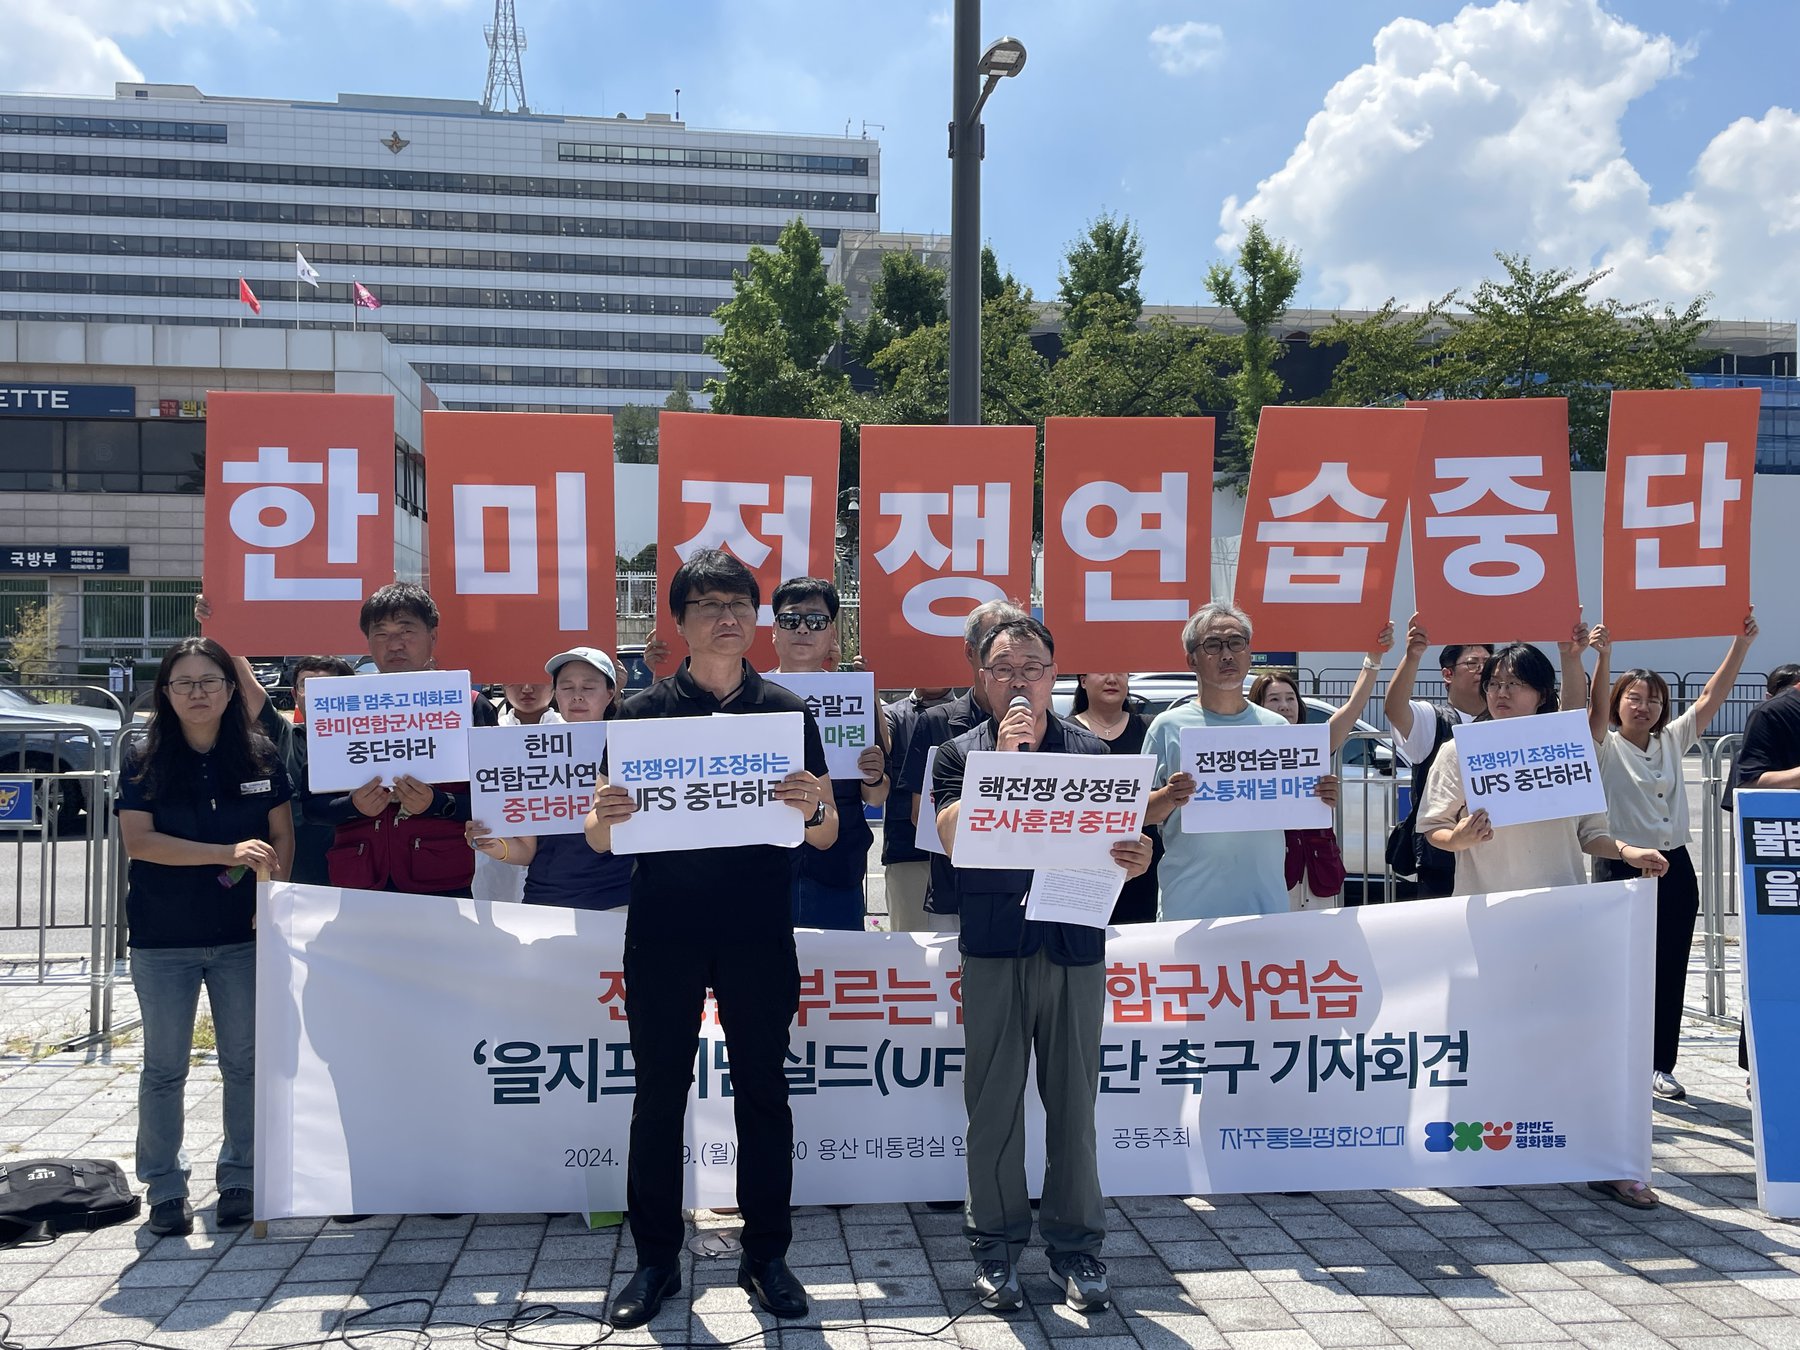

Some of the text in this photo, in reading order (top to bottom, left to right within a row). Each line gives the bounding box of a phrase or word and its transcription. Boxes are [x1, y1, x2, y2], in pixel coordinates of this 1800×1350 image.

[223, 447, 379, 601] 한
[452, 472, 589, 631] 미
[874, 482, 1011, 637] 쟁
[1061, 472, 1189, 622] 연
[1256, 462, 1388, 603] 습
[1425, 455, 1558, 596] 중
[1623, 442, 1741, 590] 단
[10, 551, 57, 567] 국방부
[313, 689, 463, 713] 적대를 멈추고 대화로!
[315, 710, 462, 737] 한미연합군사연습
[825, 724, 866, 748] 마련
[347, 736, 436, 764] 중단하라
[524, 732, 573, 759] 한미
[1467, 742, 1585, 772] 전쟁위기 조장하는
[621, 752, 791, 782] 전쟁위기 조장하는
[1195, 747, 1321, 774] 전쟁연습말고
[476, 762, 597, 793] 연합군사연
[978, 776, 1141, 803] 핵전쟁 상정한
[1194, 777, 1278, 801] 소통채널
[1471, 761, 1592, 796] UFS 중단하라
[968, 808, 1138, 834] 군사훈련 중단!
[1156, 1038, 1260, 1095] 촉구
[1269, 1030, 1469, 1093] 기자회견
[1112, 1125, 1405, 1150] 공동주최 자주통일평화연대
[1516, 1121, 1554, 1134] 한반도
[564, 1148, 619, 1168] 2024.
[818, 1137, 859, 1161] 용산
[865, 1135, 946, 1159] 대통령실
[1515, 1134, 1567, 1149] 평화행동
